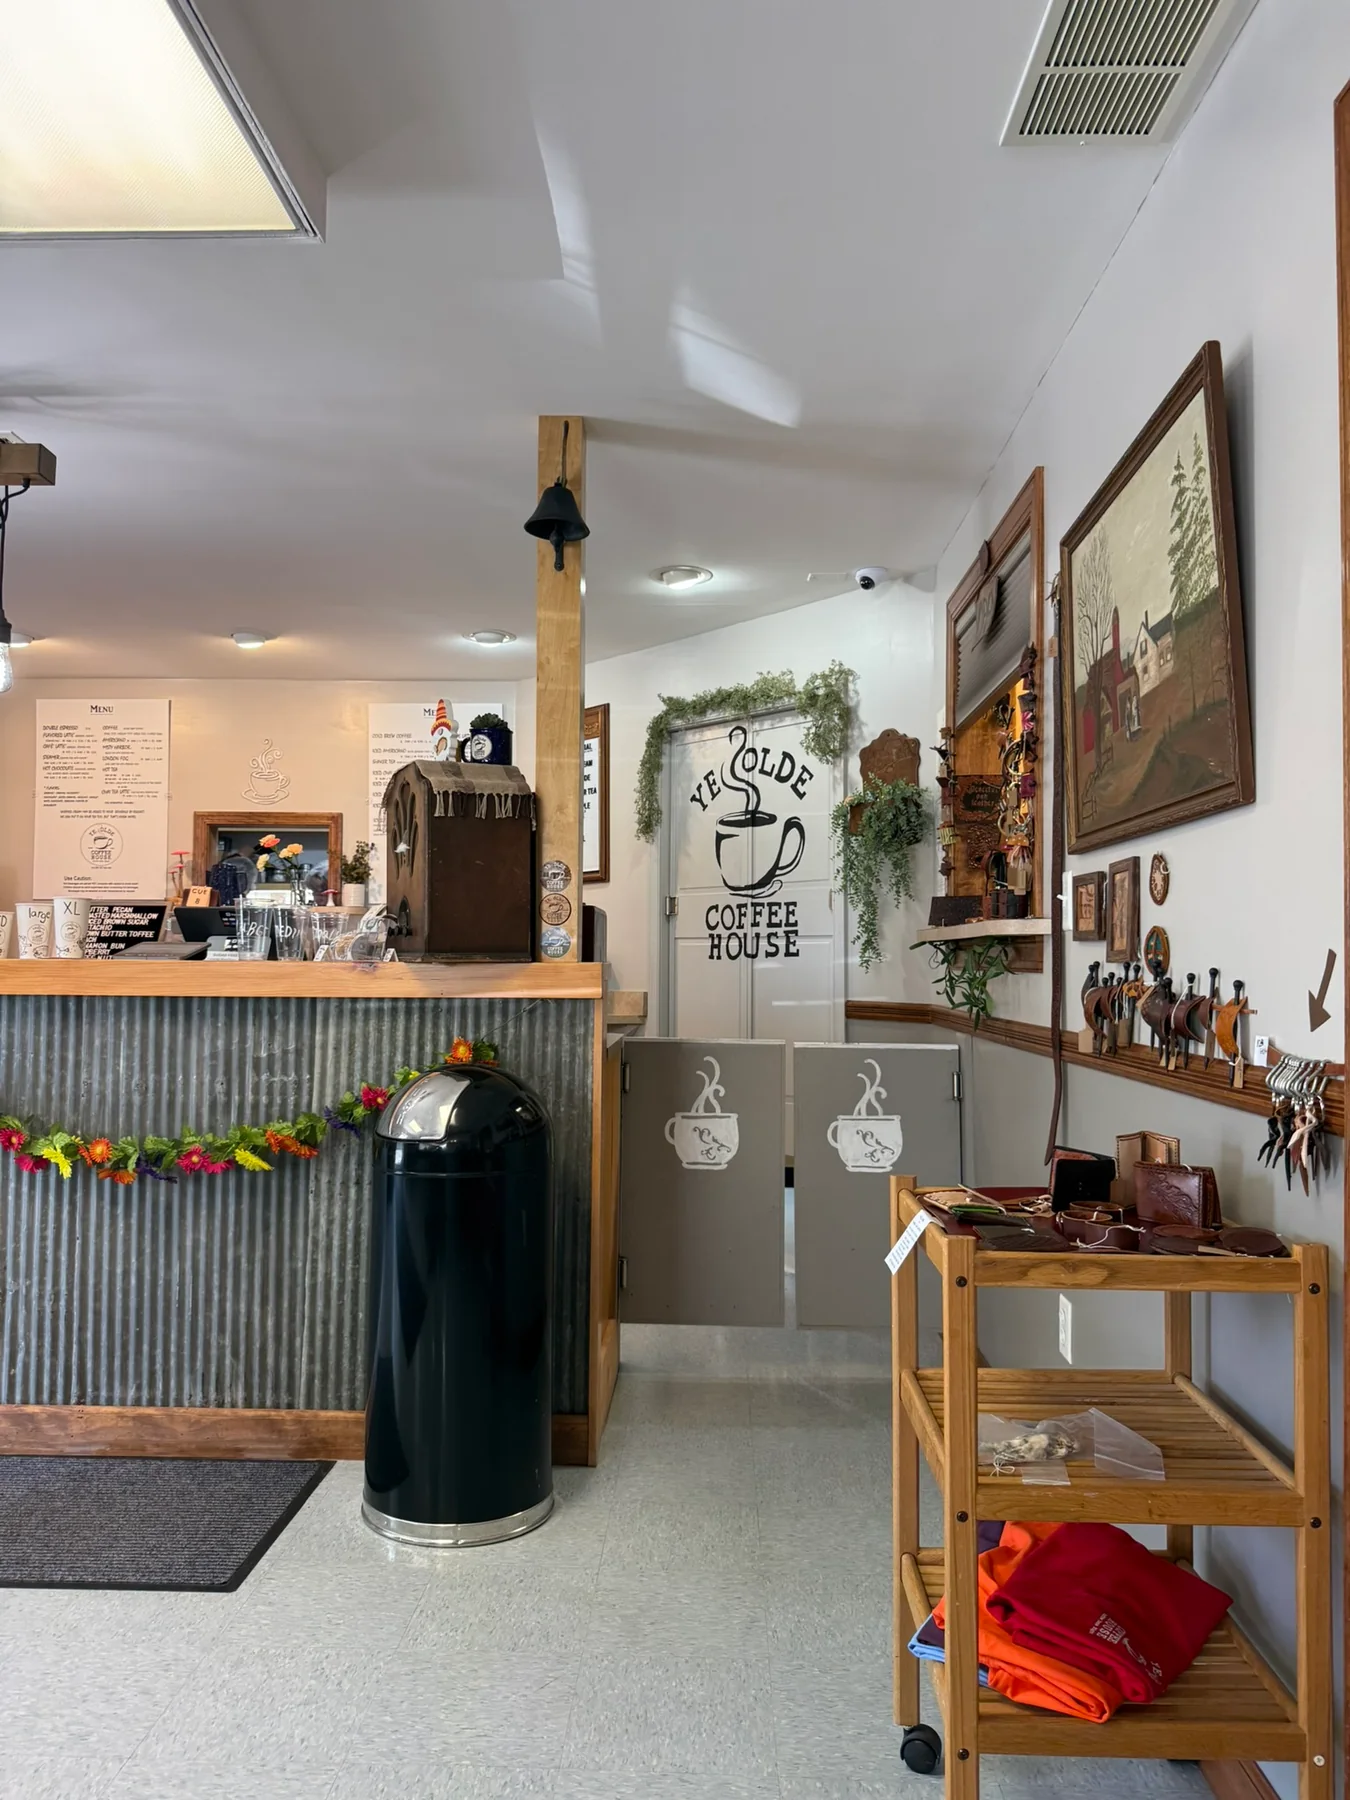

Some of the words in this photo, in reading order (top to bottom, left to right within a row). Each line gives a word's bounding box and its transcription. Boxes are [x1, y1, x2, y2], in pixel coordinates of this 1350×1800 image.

[90, 705, 114, 713] MENU
[689, 769, 722, 812] YE
[742, 747, 814, 801] OLDE
[588, 787, 597, 795] TEA
[28, 907, 51, 924] large
[63, 901, 80, 915] XL
[705, 901, 799, 932] COFFEE
[708, 930, 800, 960] HOUSE
